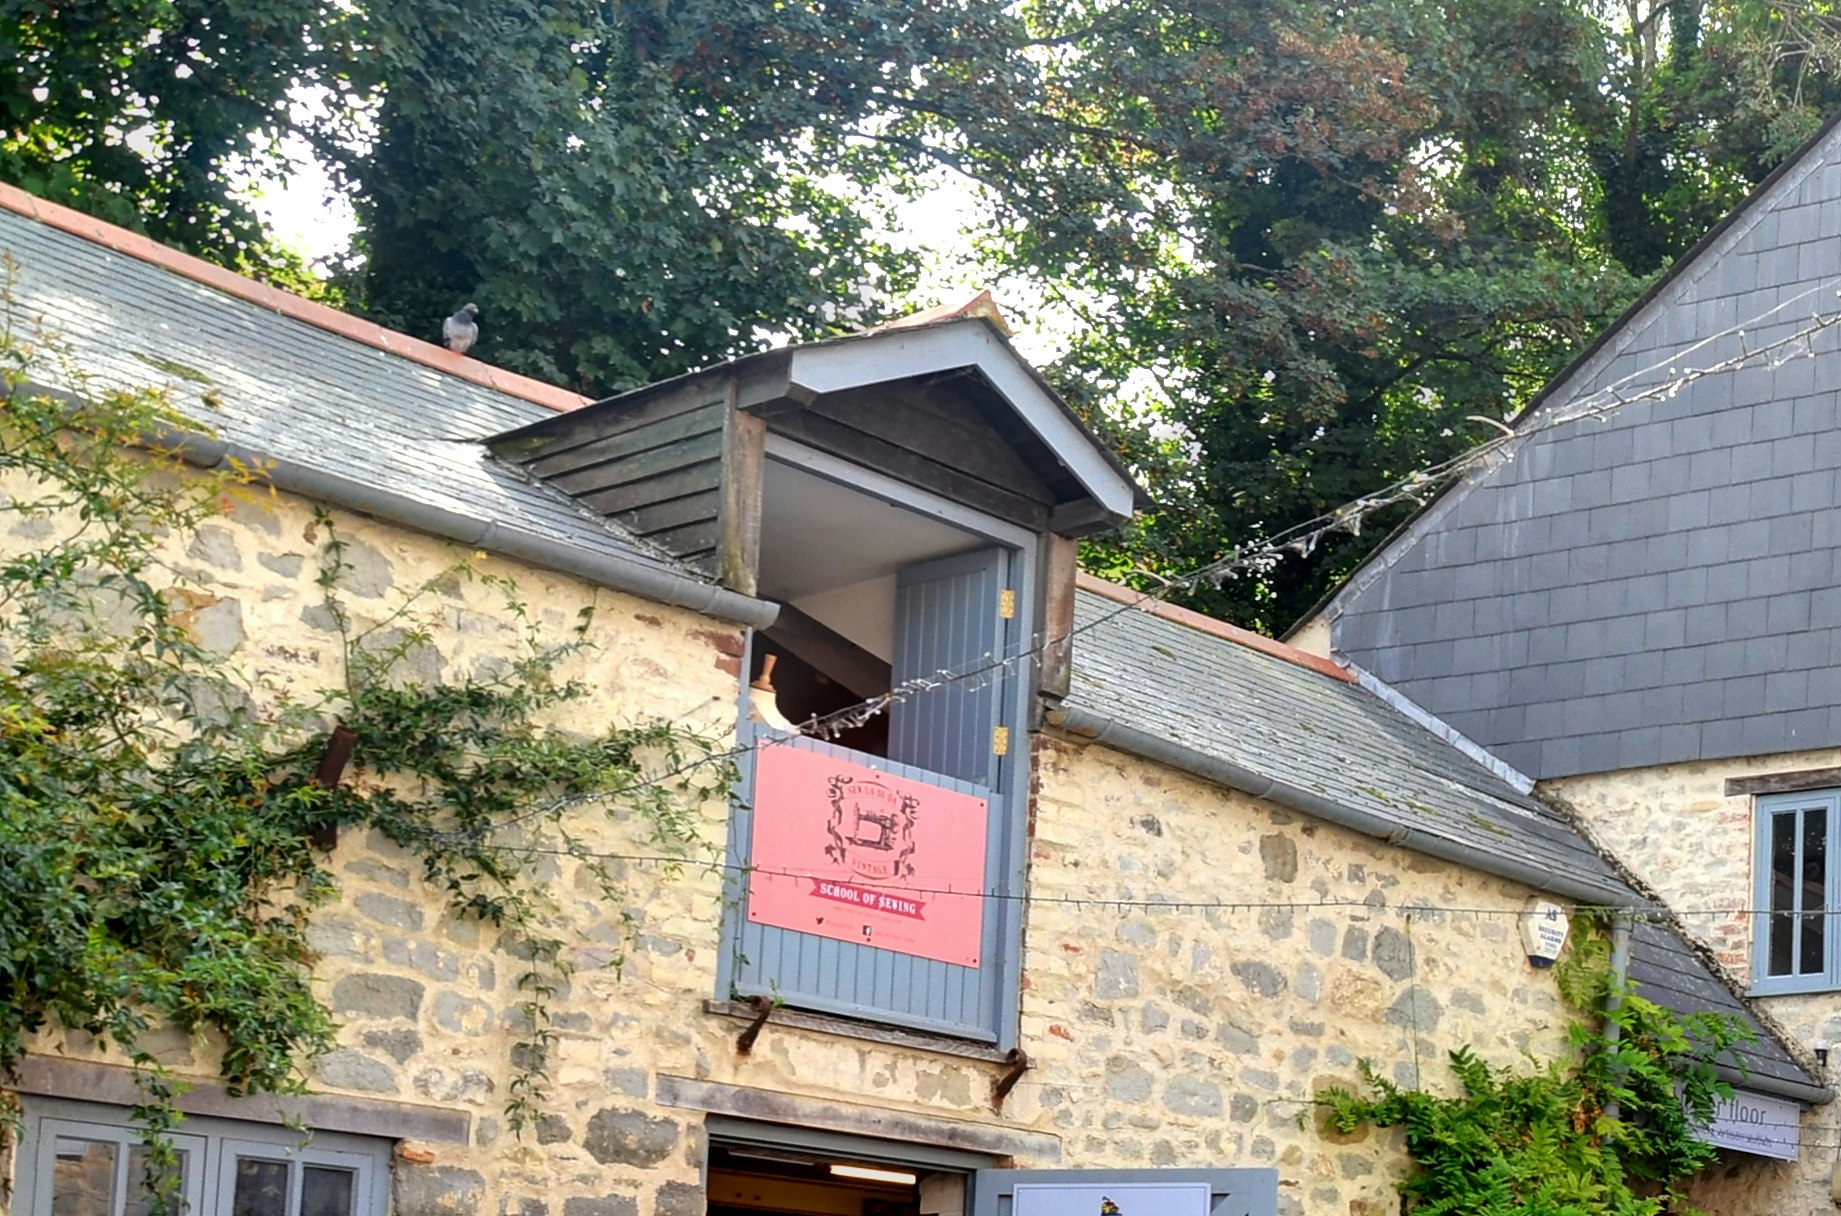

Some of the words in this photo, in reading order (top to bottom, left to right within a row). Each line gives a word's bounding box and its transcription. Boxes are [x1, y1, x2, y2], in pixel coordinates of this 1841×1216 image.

[820, 883, 860, 902] SCHOOL
[862, 892, 877, 905] OF
[879, 896, 916, 914] SEWING
[1729, 1099, 1767, 1125] floor
